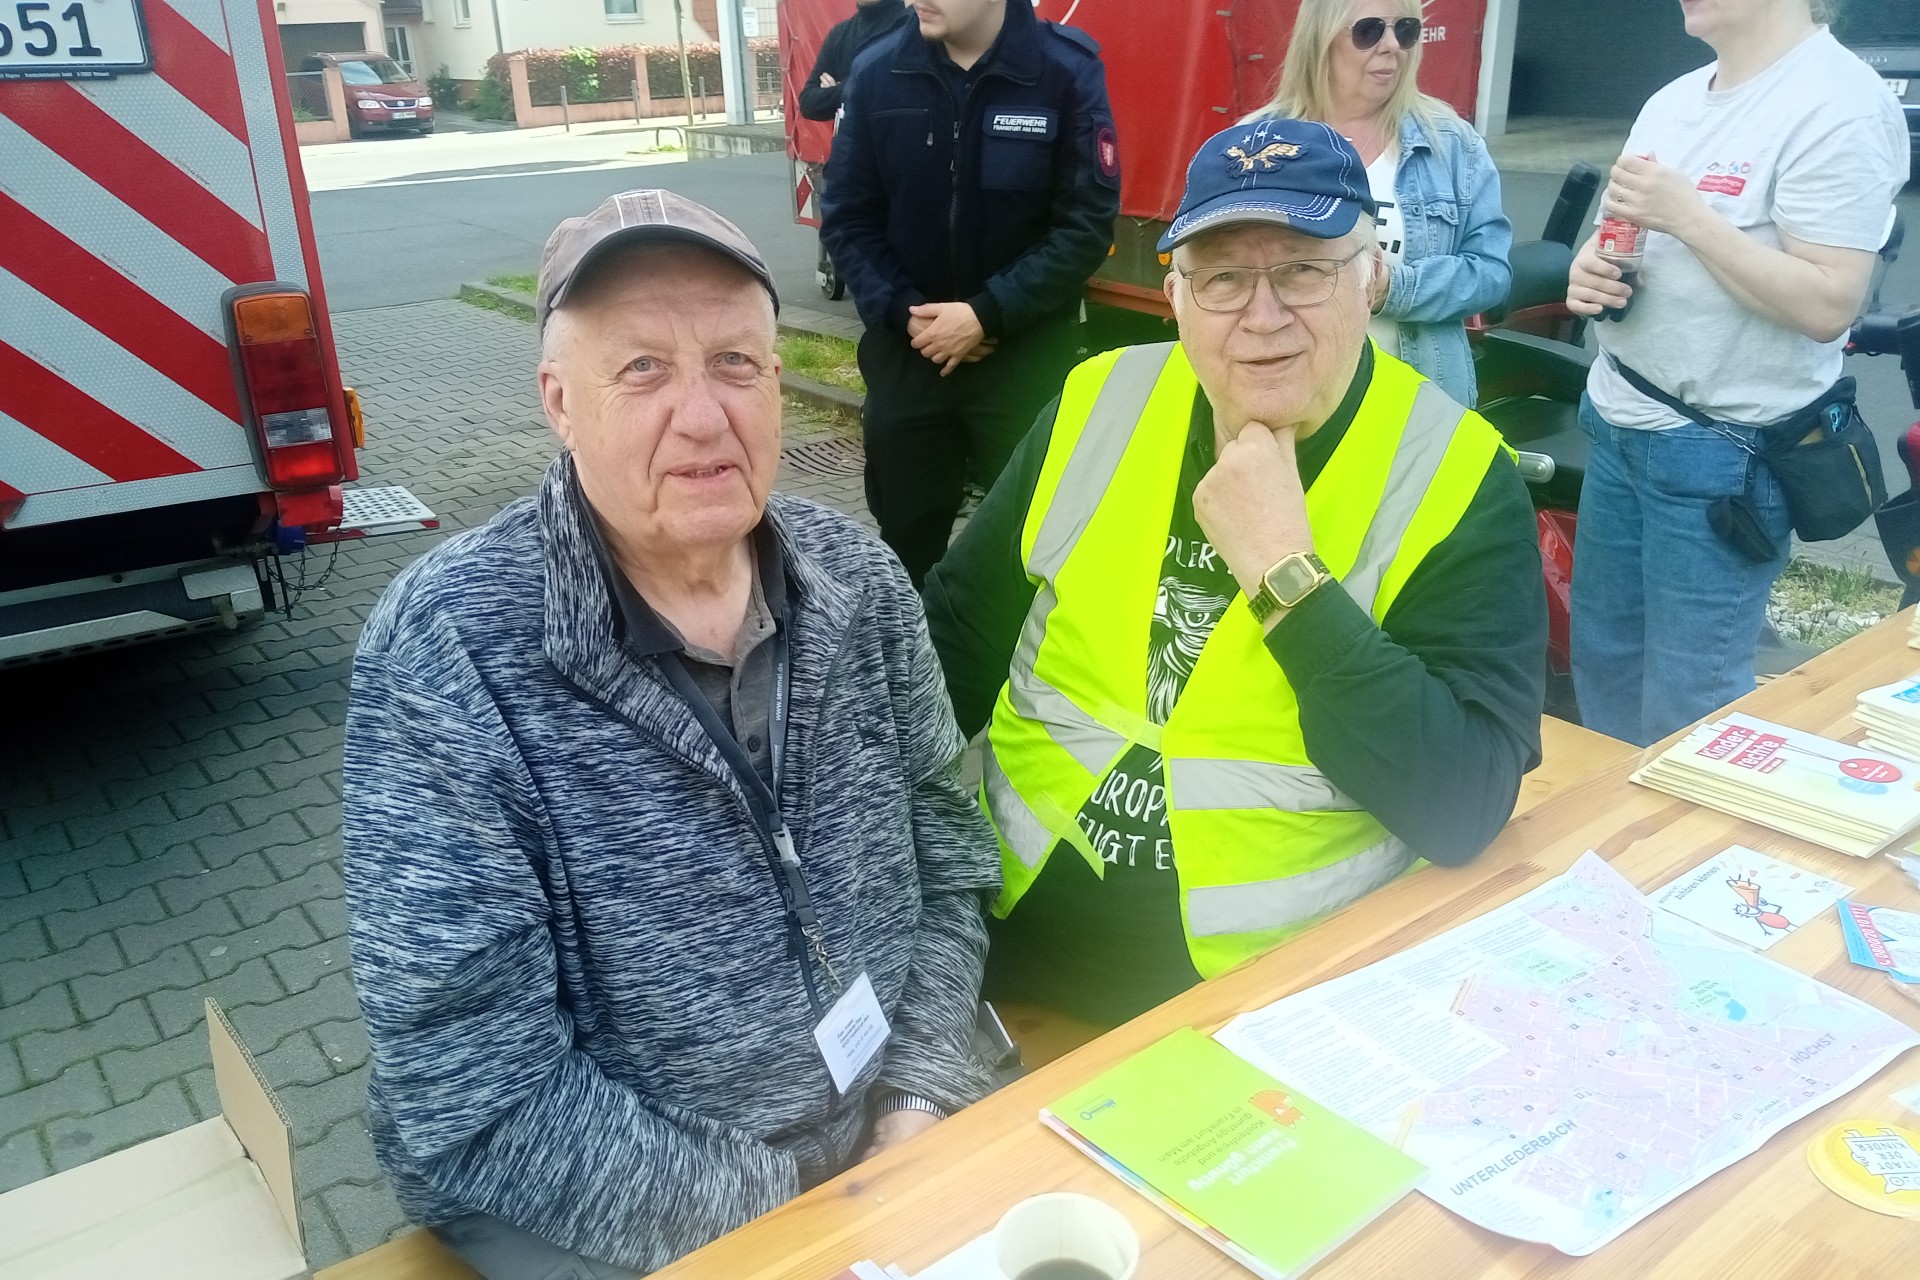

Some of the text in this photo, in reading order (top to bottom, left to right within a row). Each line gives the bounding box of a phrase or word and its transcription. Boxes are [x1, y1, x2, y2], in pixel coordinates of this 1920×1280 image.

[993, 115, 1048, 128] FEUERWEHR
[993, 124, 1022, 132] FRANKFURT
[775, 662, 784, 721] www.semmel.de
[1699, 728, 1748, 760] Kinder-
[1736, 740, 1780, 768] rechte
[1155, 838, 1177, 870] E
[1158, 1105, 1244, 1162] in Frankfurt am Main
[1198, 1119, 1265, 1165] Kostenfreie und
[1854, 1142, 1907, 1152] KINDER
[1173, 1137, 1217, 1166] Angebote
[1449, 1118, 1578, 1196] UNTERLIEDERBACH
[1875, 1151, 1904, 1160] DER
[1877, 1160, 1918, 1170] STADT
